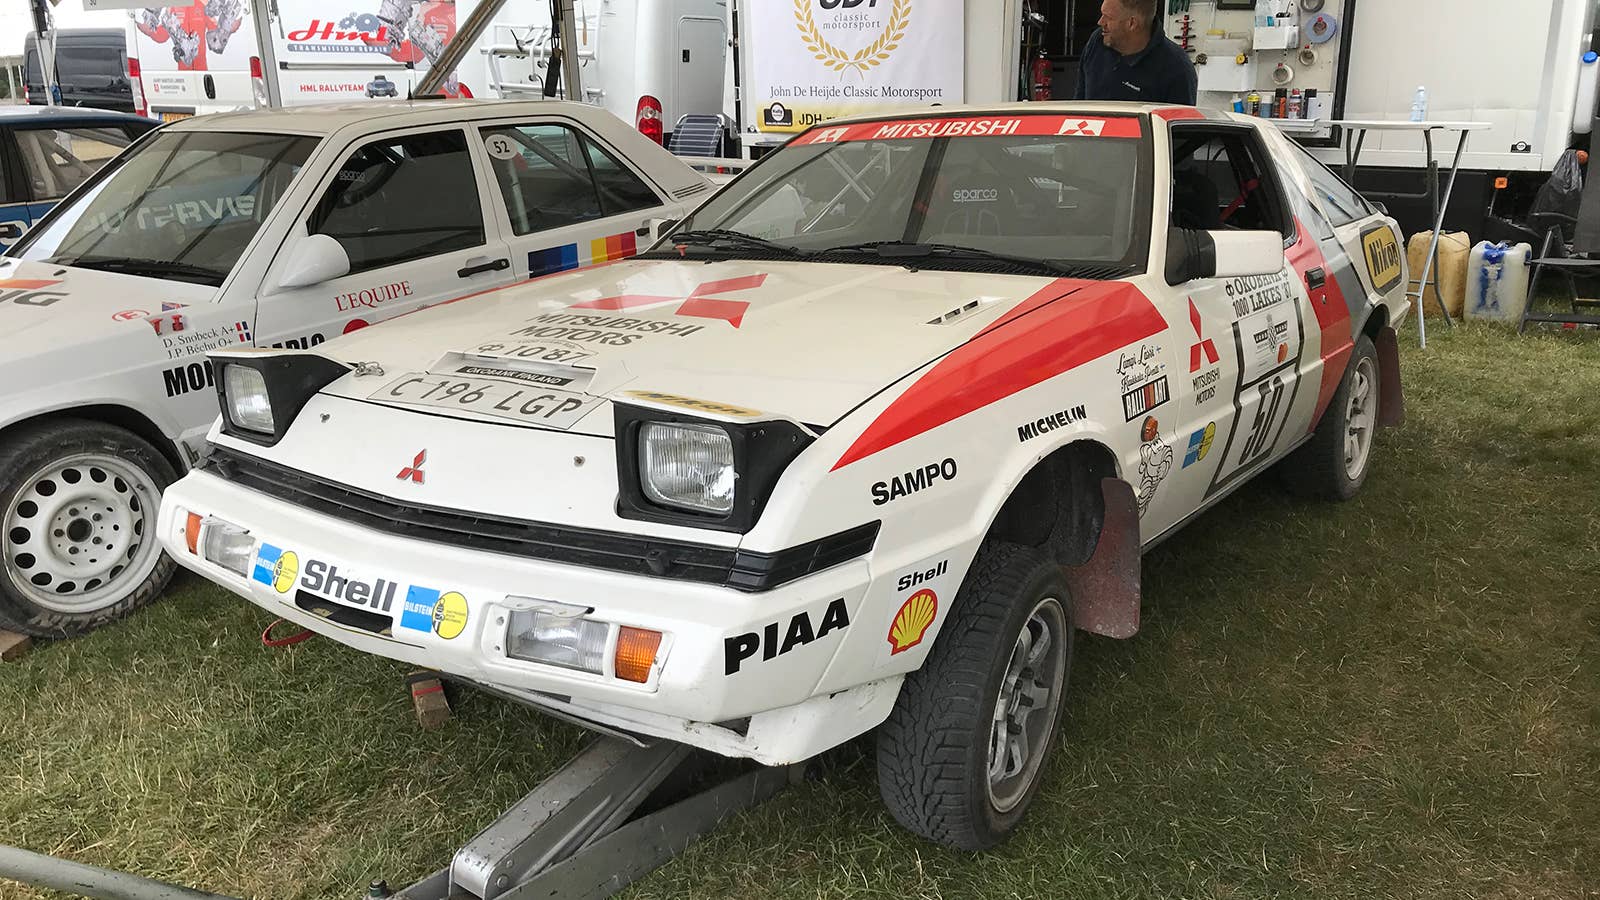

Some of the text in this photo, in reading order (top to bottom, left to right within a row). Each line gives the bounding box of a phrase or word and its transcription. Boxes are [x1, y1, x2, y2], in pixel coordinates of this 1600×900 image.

[823, 20, 880, 31] motorsport
[833, 12, 869, 21] classic
[300, 84, 364, 92] HML RALLYTEAM
[770, 86, 942, 101] John De Heijde Classic Motorsport
[872, 120, 1021, 139] MITSUBISHI
[493, 140, 510, 153] 52
[334, 281, 414, 312] L'EQUIPE
[1233, 297, 1249, 318] 1000
[1250, 286, 1282, 312] LAKES
[163, 326, 236, 348] D. Snobeck A+
[508, 325, 644, 346] MOTORS
[526, 313, 706, 338] MITSUBISHI
[218, 338, 233, 347] O+
[514, 372, 562, 385] FINLAND
[493, 390, 583, 419] LGP
[1017, 404, 1088, 442] MICHELIN
[1239, 375, 1285, 466] 50
[871, 457, 958, 506] SAMPO
[300, 558, 398, 612] Shell
[897, 559, 948, 592] Shell
[724, 597, 850, 676] PIAA
